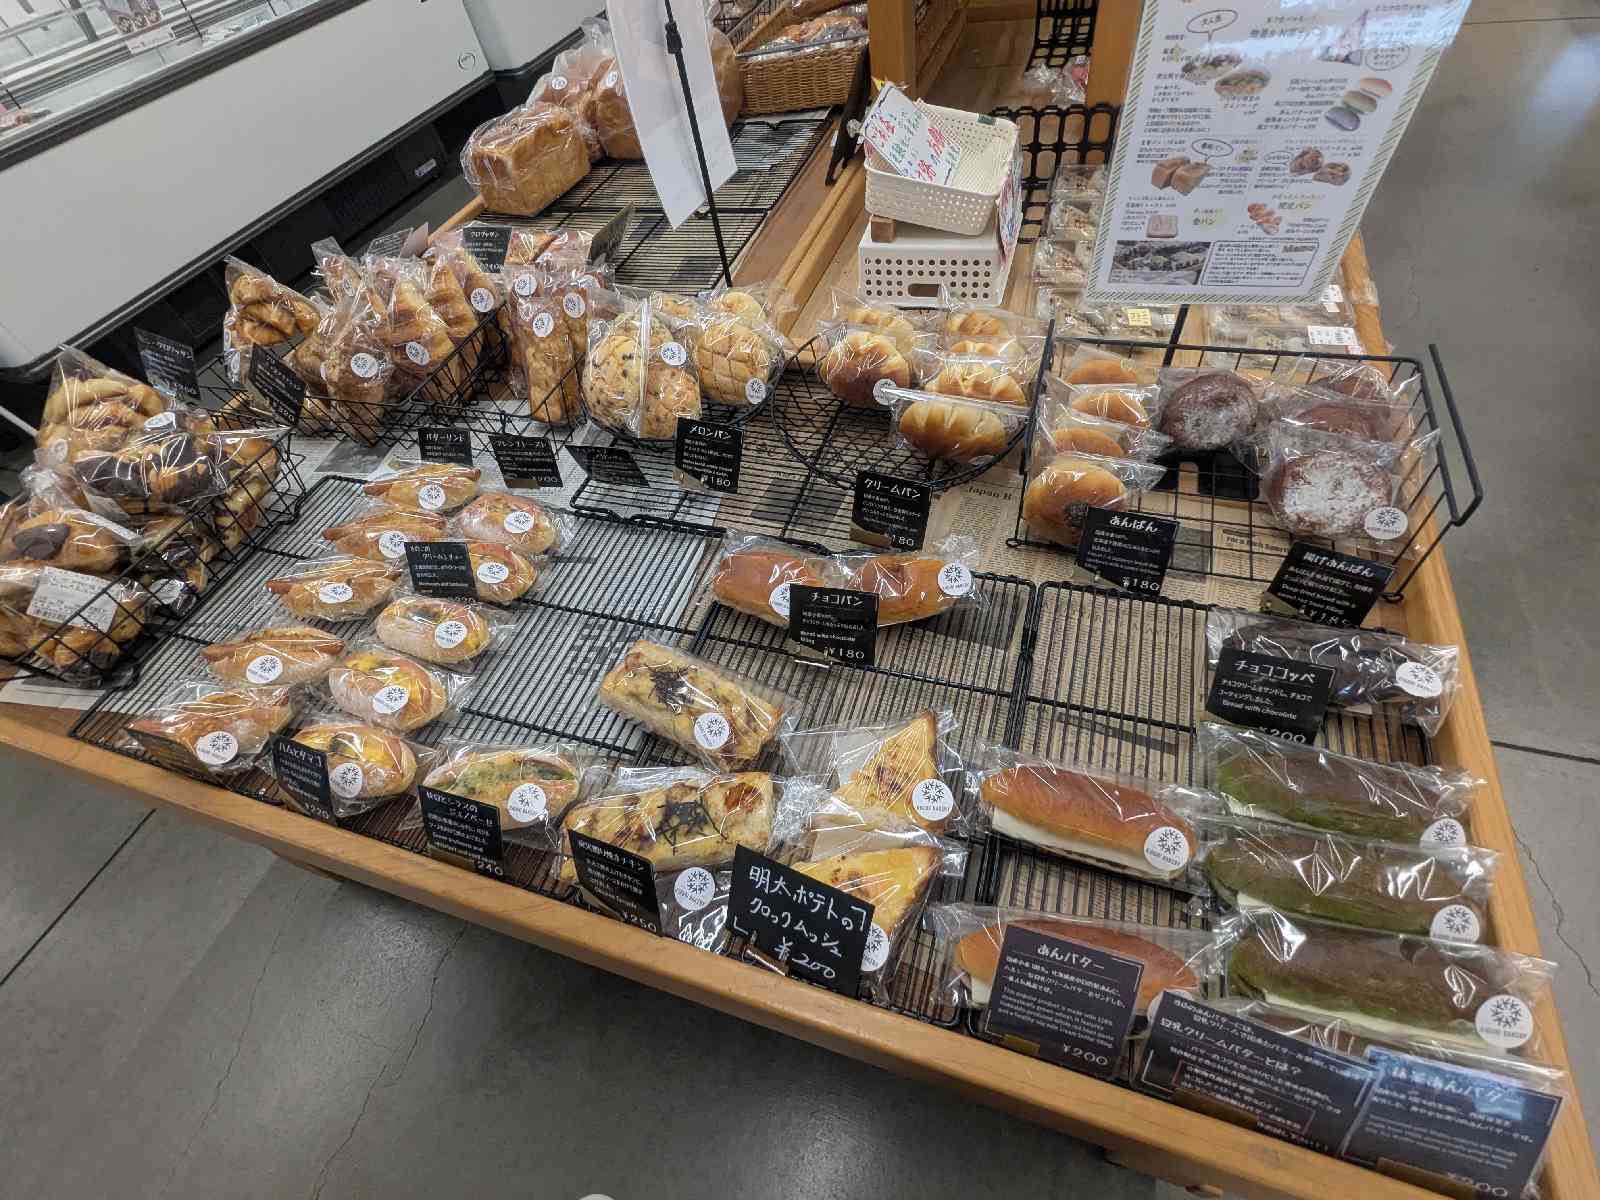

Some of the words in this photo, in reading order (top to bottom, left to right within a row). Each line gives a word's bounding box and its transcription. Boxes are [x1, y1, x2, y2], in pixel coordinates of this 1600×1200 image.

[688, 425, 732, 440] メロンパン
[864, 479, 921, 498] クリームパン
[1122, 576, 1161, 591] ¥180
[811, 592, 863, 606] チョコパン
[1234, 660, 1316, 684] チョココッペ
[1262, 707, 1298, 720] chocolate
[749, 865, 854, 931] 明太ポテトの
[774, 935, 836, 979] ¥200
[1037, 943, 1105, 969] あんバター
[1063, 1043, 1108, 1066] ¥200
